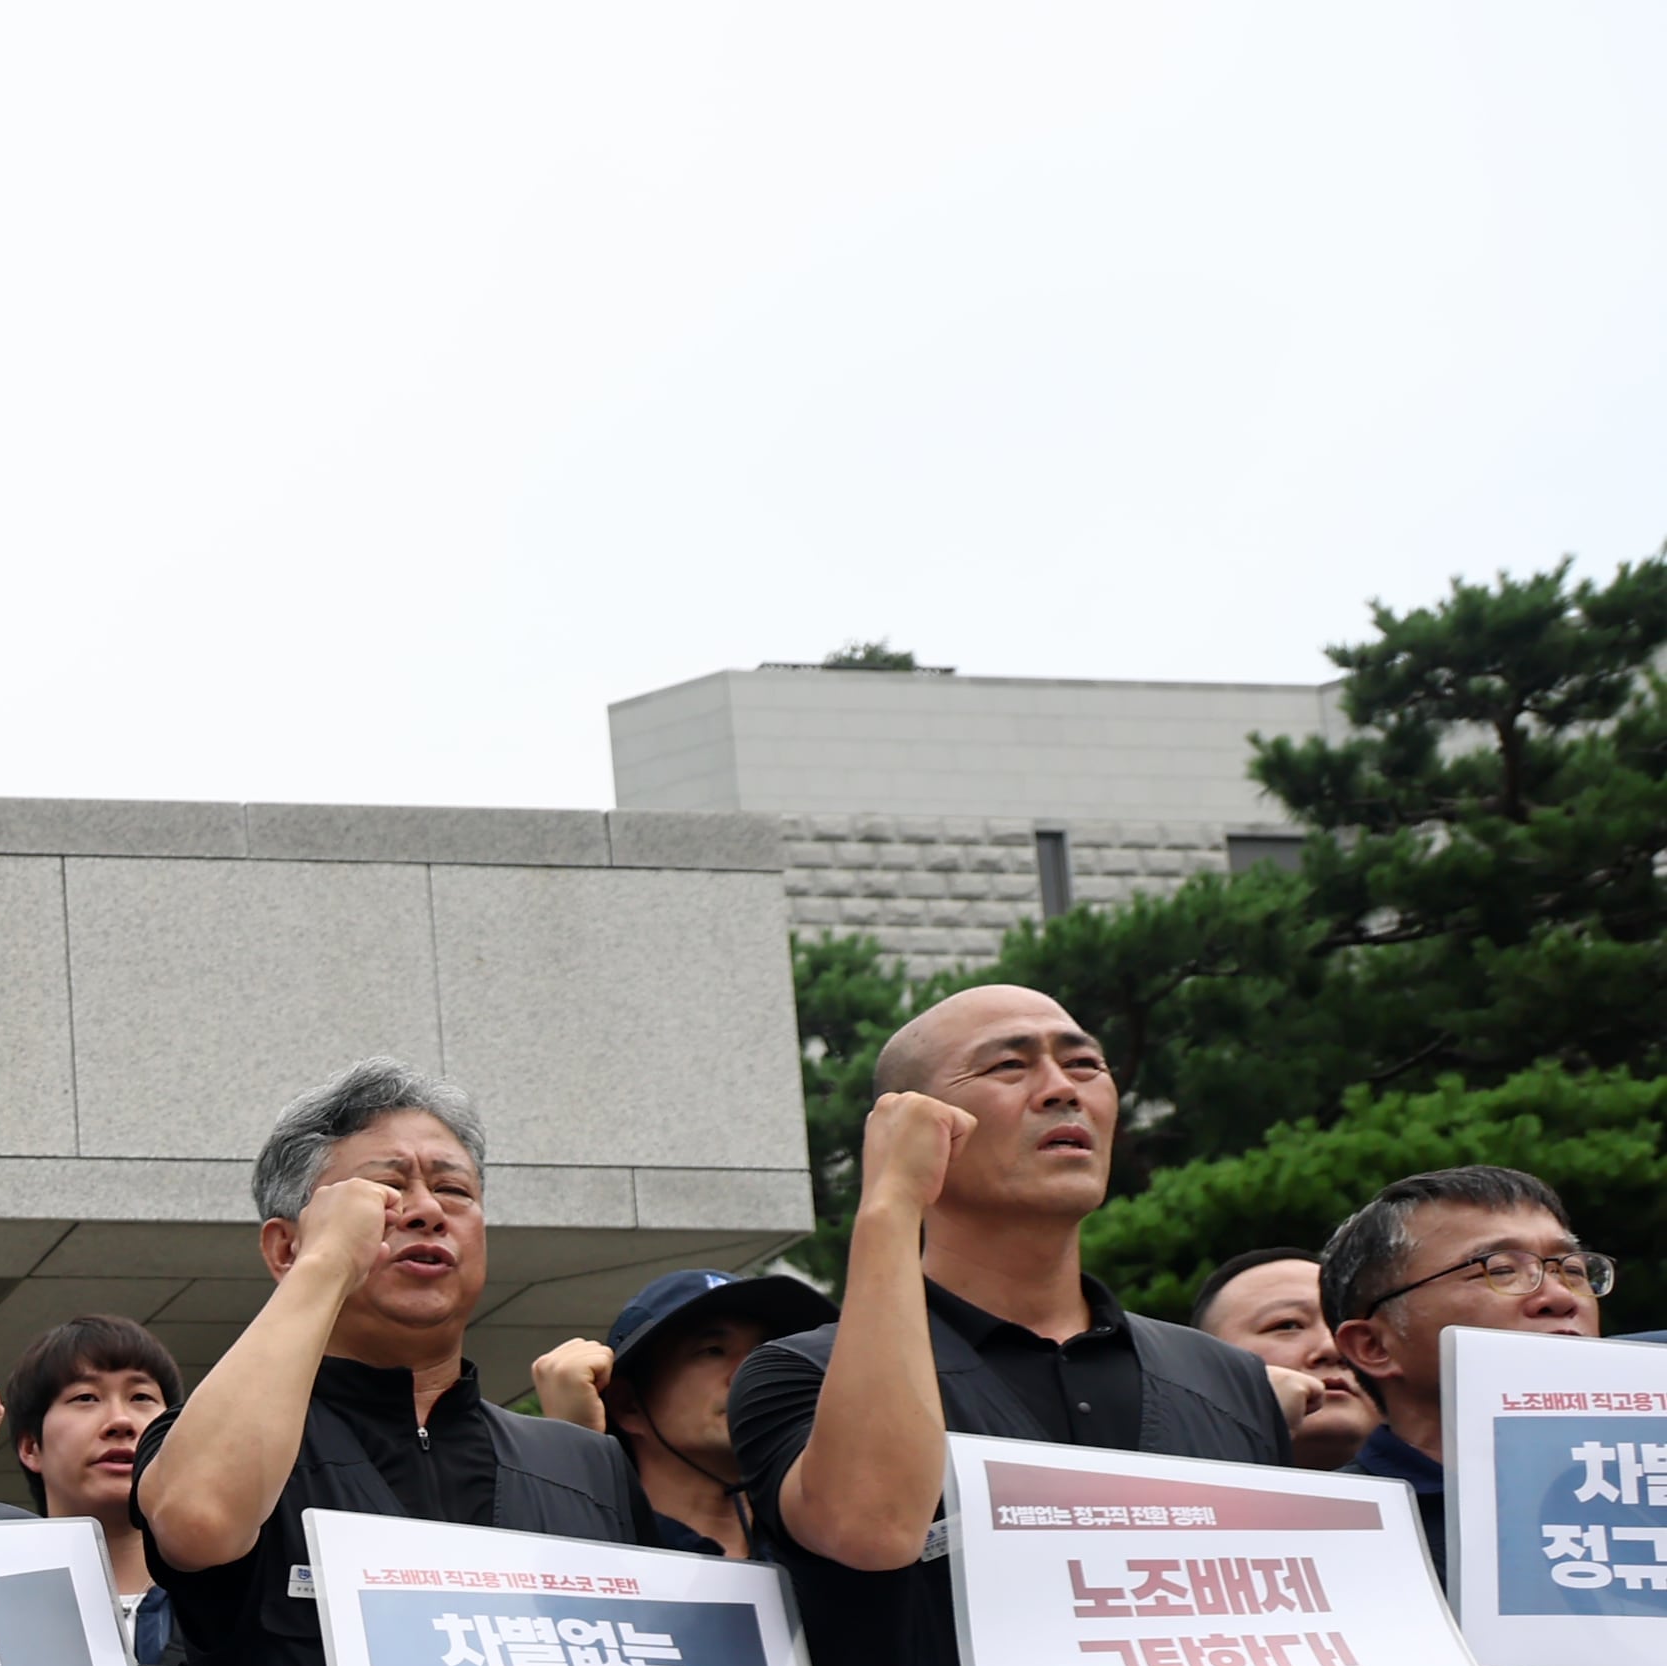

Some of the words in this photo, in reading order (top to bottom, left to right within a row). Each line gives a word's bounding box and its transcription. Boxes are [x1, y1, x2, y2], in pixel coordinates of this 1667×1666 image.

[1502, 1392, 1588, 1411] 노조배제
[998, 1505, 1073, 1526] 차별없는
[1073, 1505, 1131, 1526] 정규직
[1131, 1505, 1170, 1526] 전환
[362, 1569, 443, 1587] 노조배제
[444, 1570, 538, 1589] 직고용기만
[540, 1574, 596, 1593] 포스코
[597, 1577, 641, 1595] 규탄!
[1067, 1557, 1333, 1618] 노조배제
